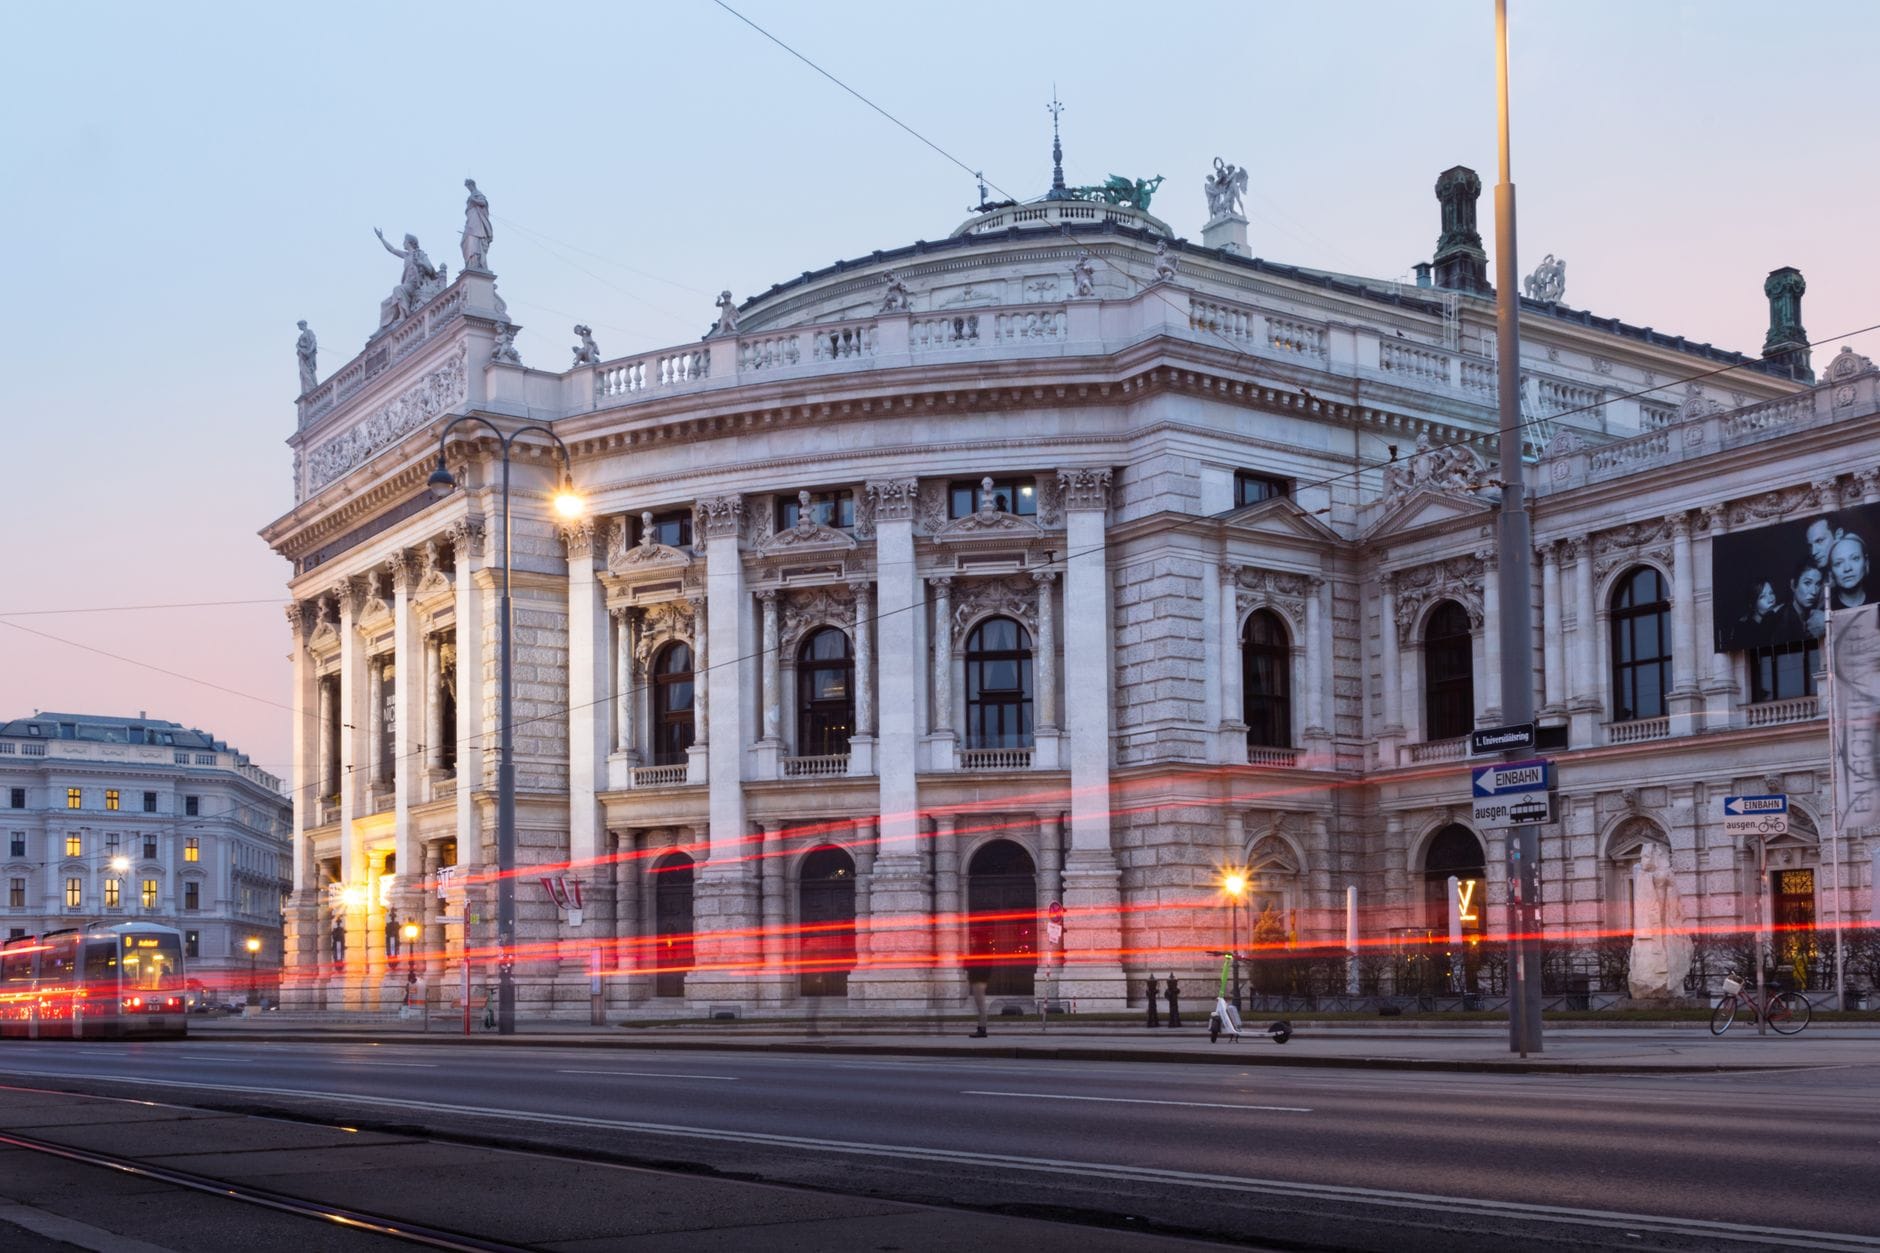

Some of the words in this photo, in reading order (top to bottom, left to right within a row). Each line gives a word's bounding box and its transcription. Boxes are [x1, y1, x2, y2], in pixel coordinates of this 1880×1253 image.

[1482, 731, 1529, 746] Universitätsring
[1495, 768, 1539, 787] EINBAHN
[1743, 799, 1780, 810] EINBAHN
[1475, 804, 1509, 821] ausgen.
[1726, 821, 1757, 831] ausgen.
